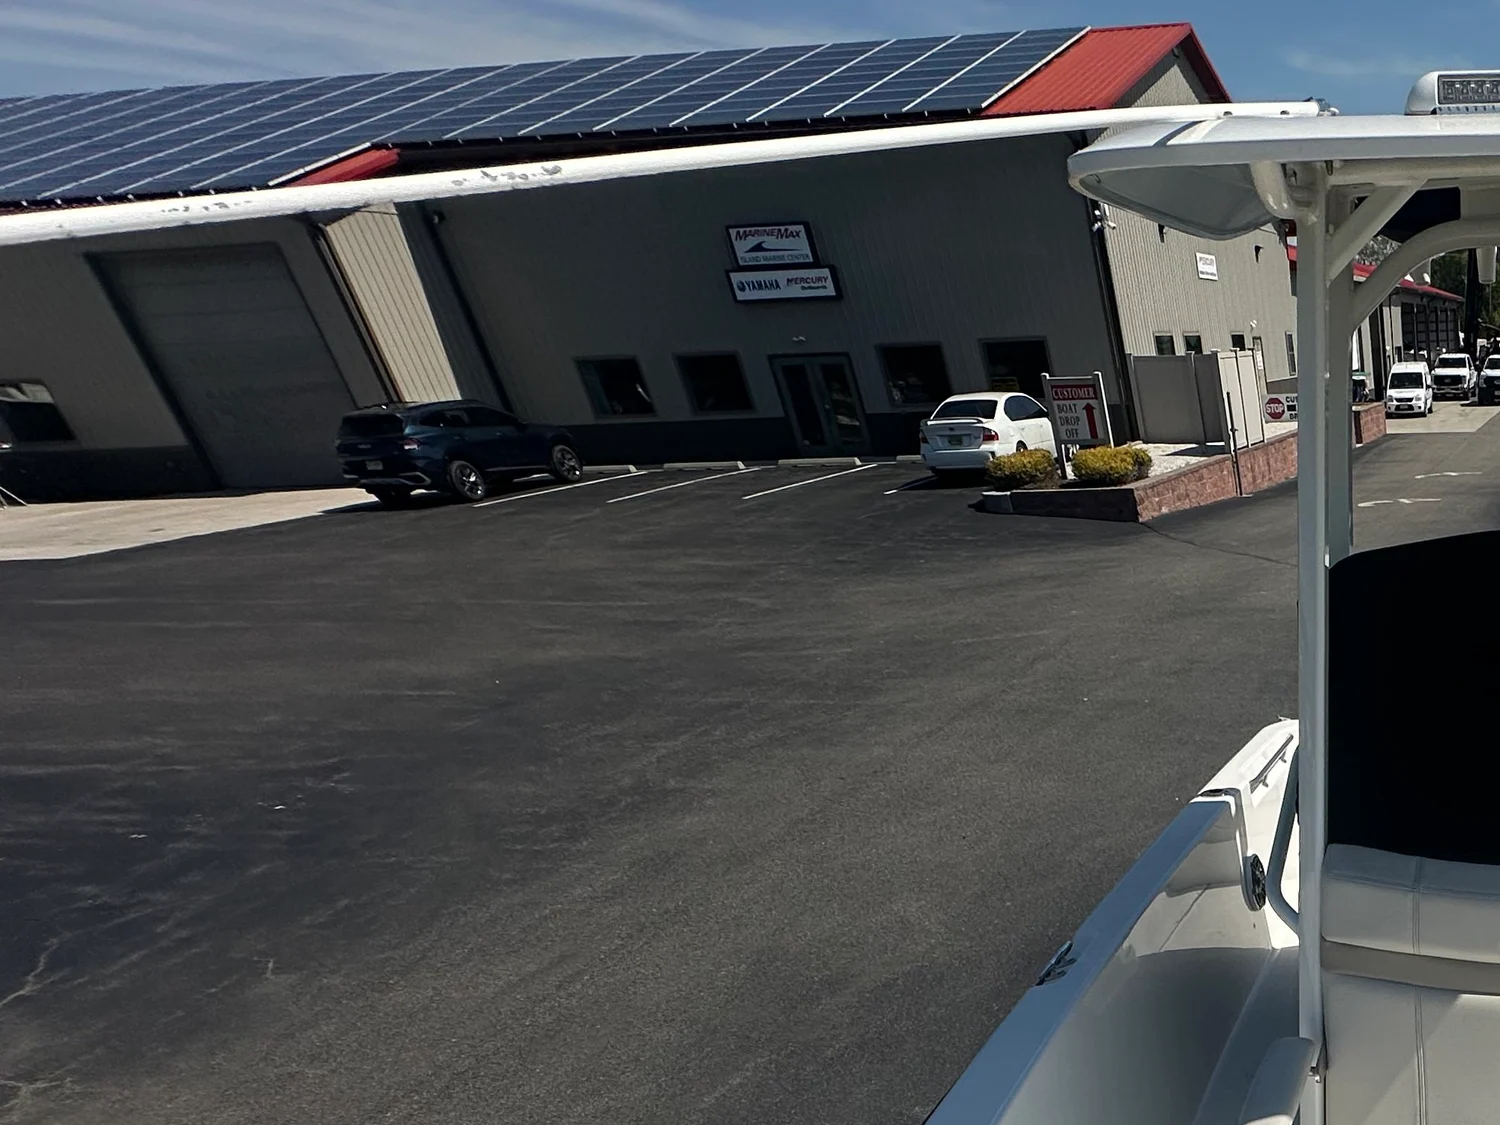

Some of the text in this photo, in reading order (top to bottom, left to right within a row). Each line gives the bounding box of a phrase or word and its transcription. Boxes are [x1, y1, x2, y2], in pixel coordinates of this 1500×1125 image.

[745, 279, 782, 291] YAMAHA
[786, 276, 828, 286] MERCURY
[1052, 388, 1094, 398] CUSTOMER
[1057, 404, 1077, 413] BOAT
[1266, 404, 1284, 413] STOP
[1060, 416, 1080, 426] DROP
[1065, 428, 1080, 439] OFF
